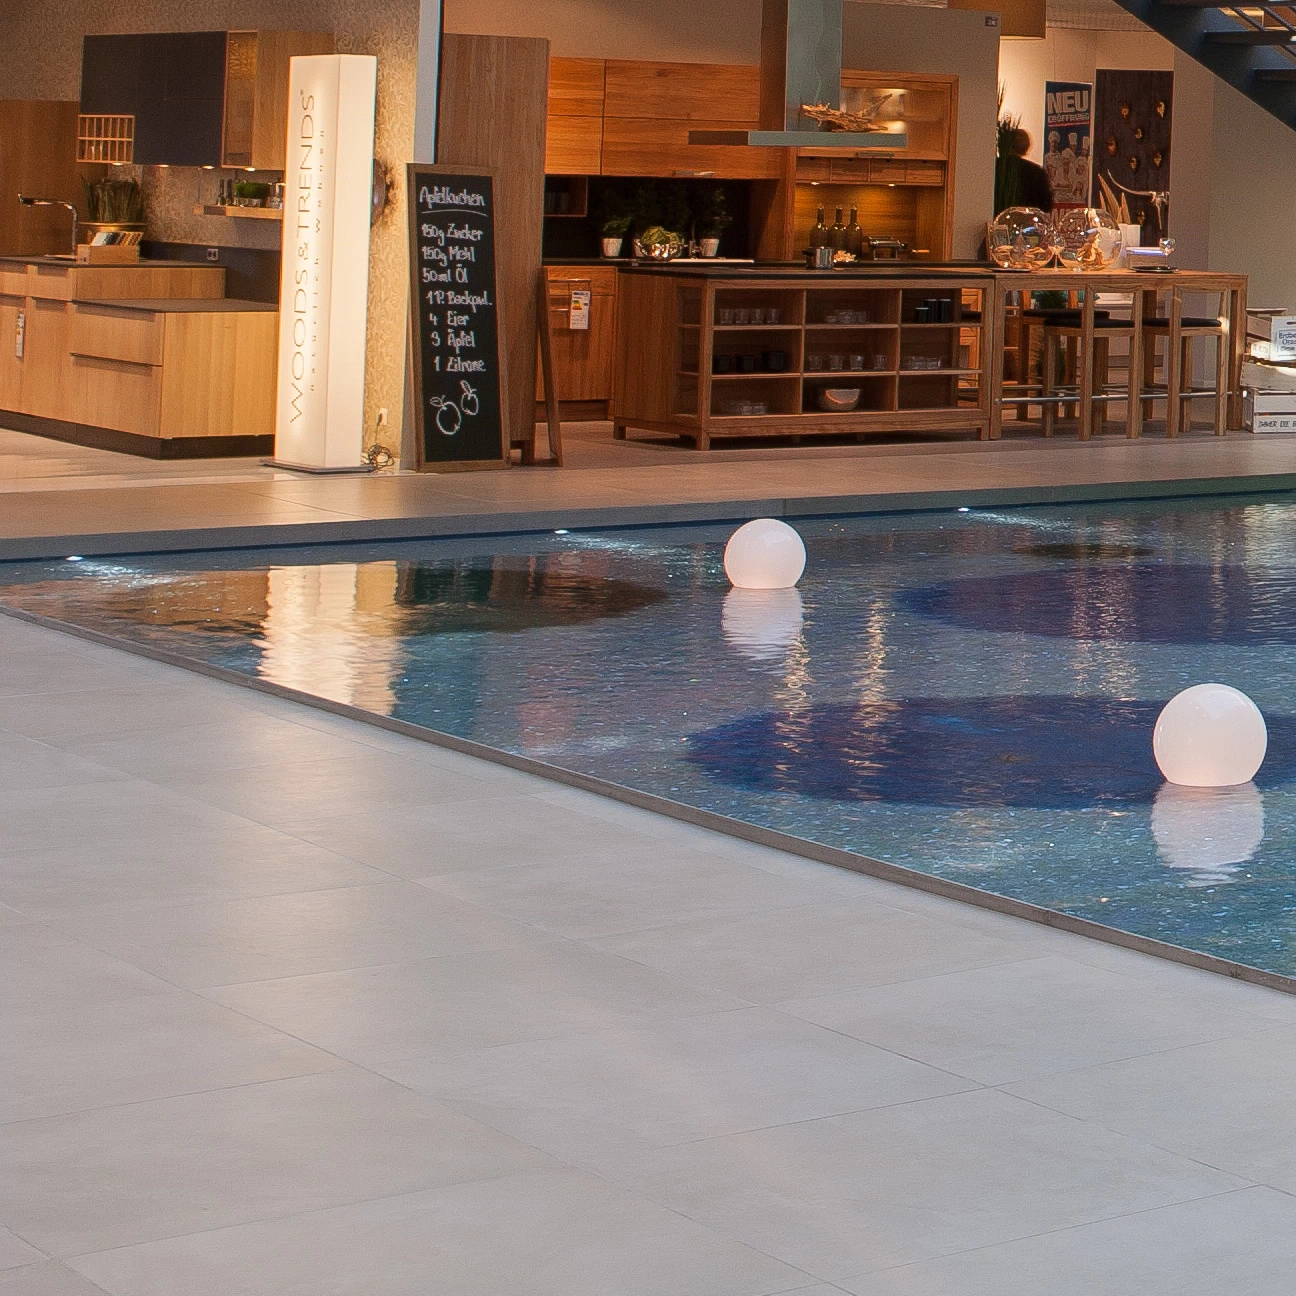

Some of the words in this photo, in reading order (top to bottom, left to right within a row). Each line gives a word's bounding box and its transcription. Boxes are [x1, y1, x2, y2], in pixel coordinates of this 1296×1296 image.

[1047, 90, 1089, 114] NEU
[420, 185, 486, 209] Apfelkuchen
[421, 223, 446, 247] 150g
[446, 223, 484, 242] Zucker
[421, 245, 449, 267] 150g
[448, 245, 476, 263] Mehl
[421, 267, 452, 283] 50ml
[455, 263, 469, 283] Öl
[429, 312, 438, 326] 4
[446, 310, 470, 327] Eier
[289, 268, 308, 423] WOODS
[447, 328, 476, 355] Äpfel
[433, 355, 440, 372] 1
[446, 356, 488, 373] Zitrone
